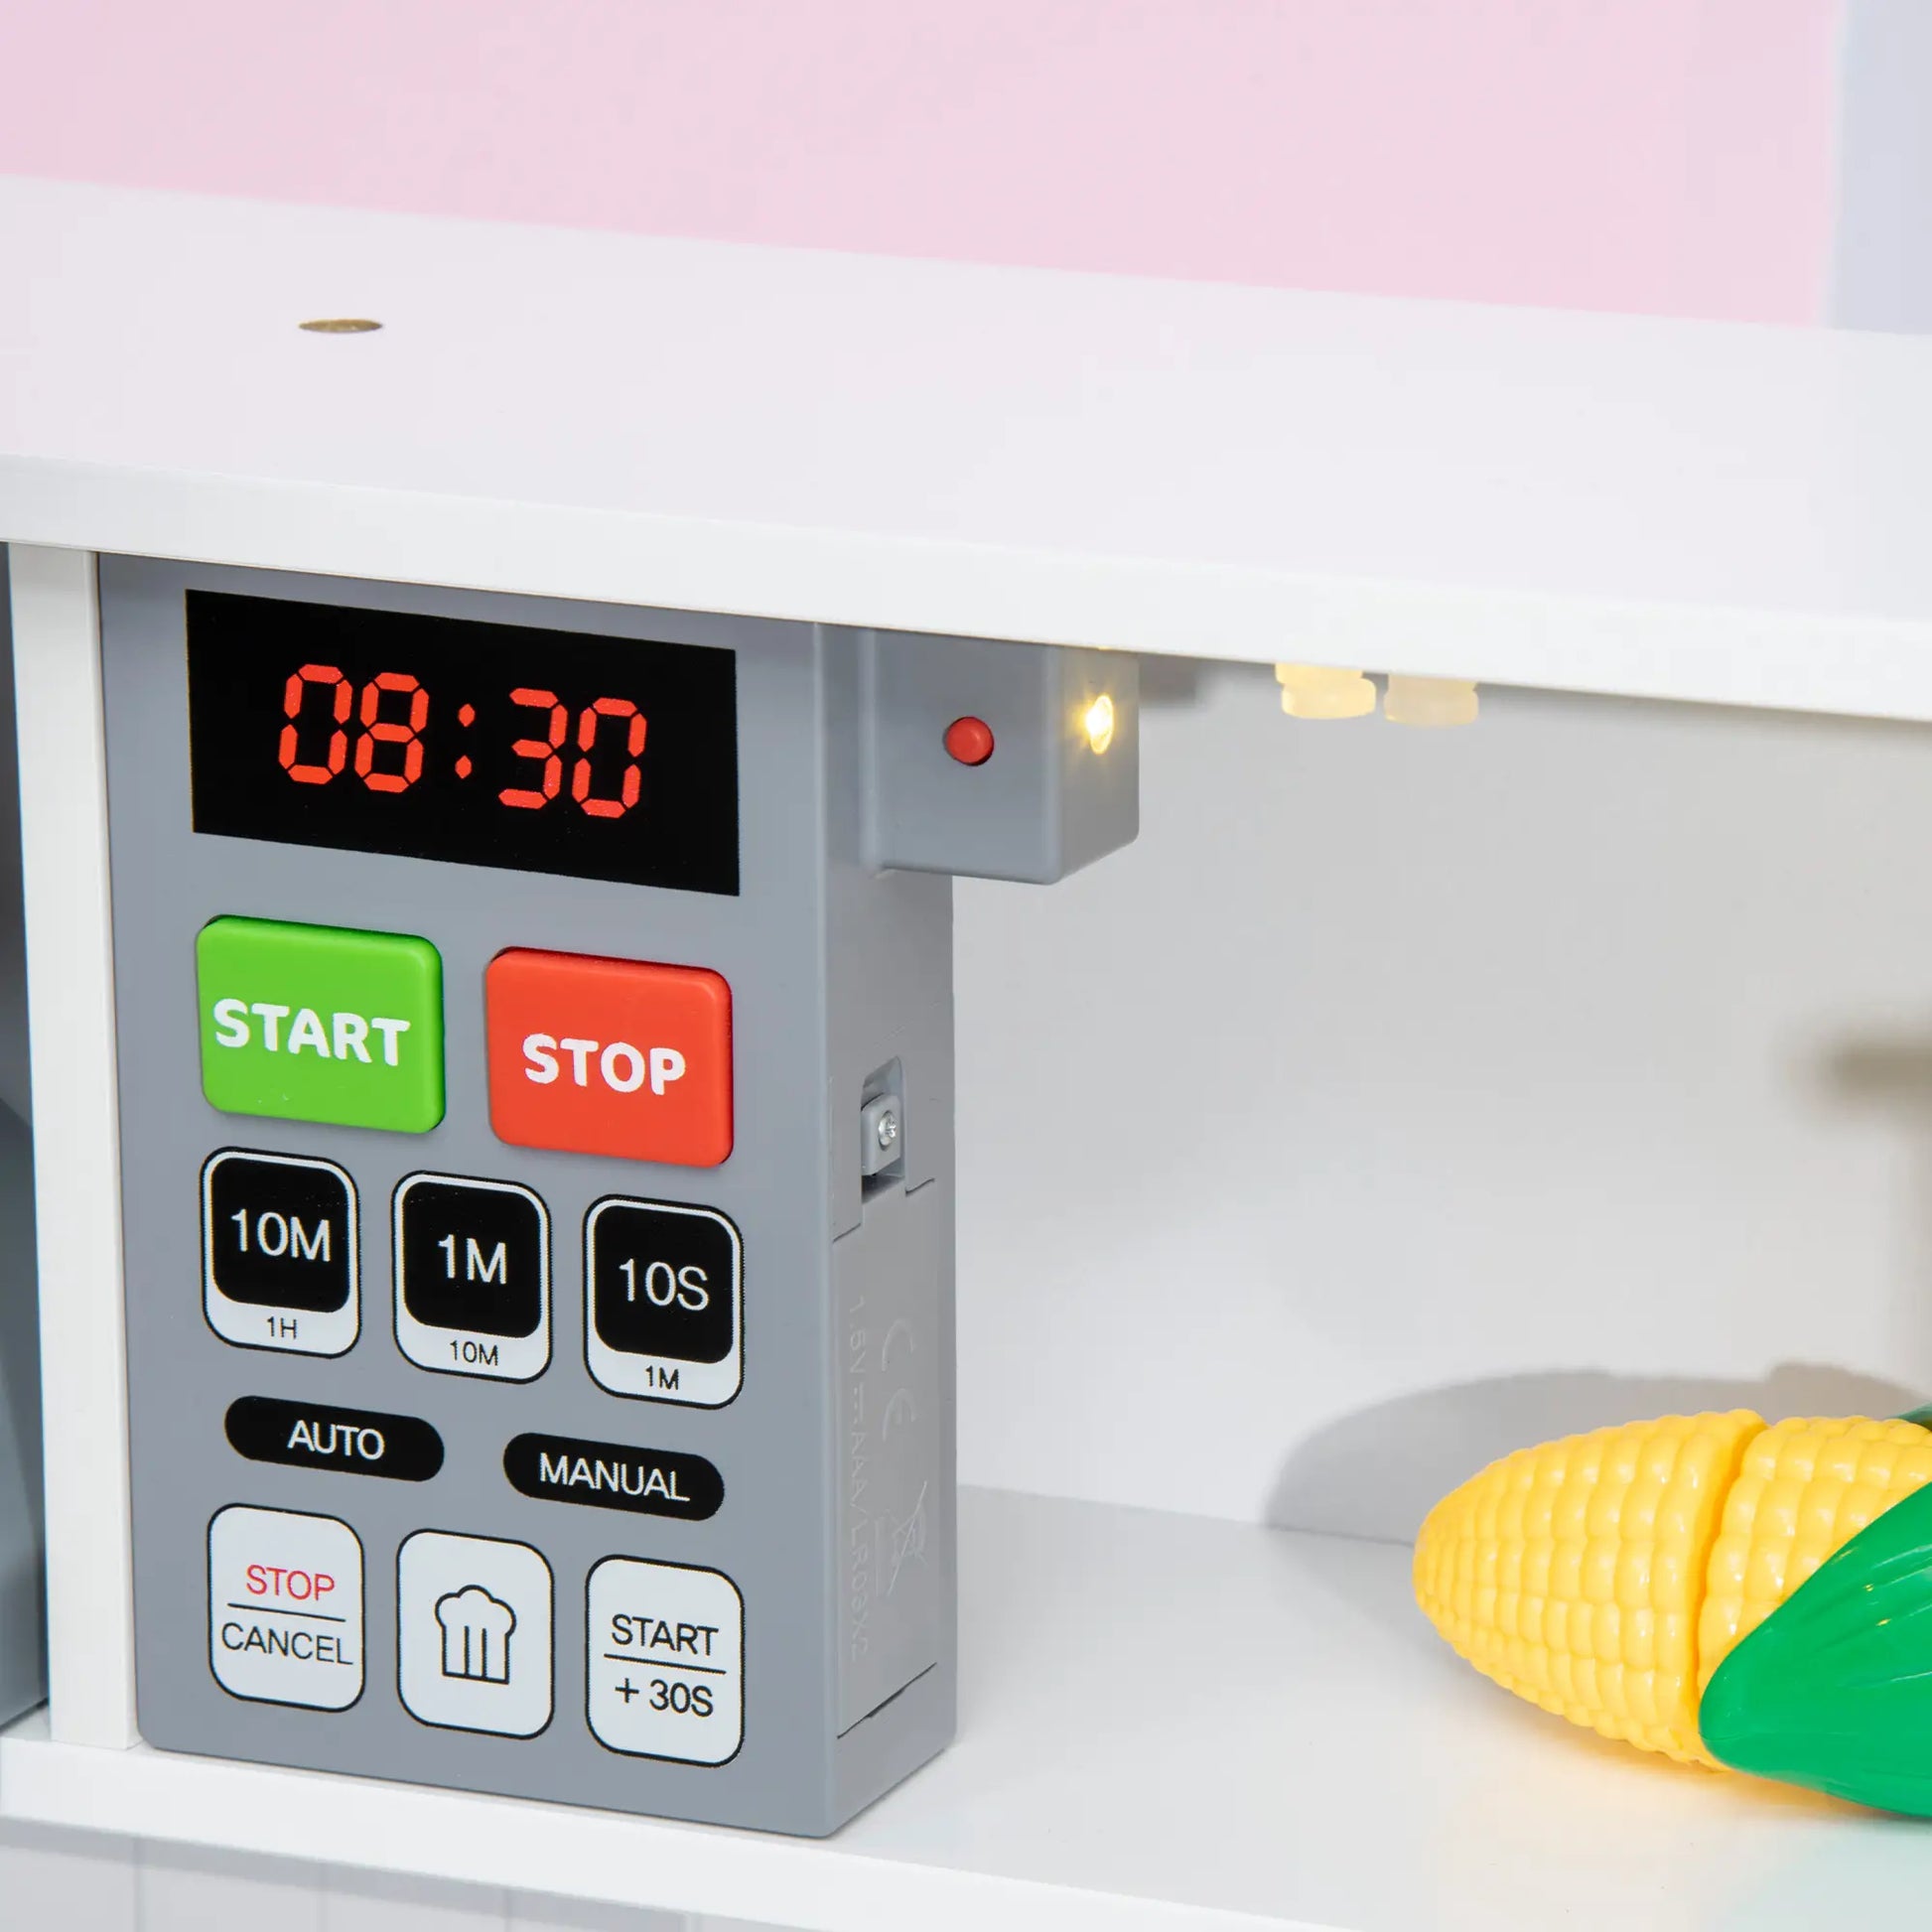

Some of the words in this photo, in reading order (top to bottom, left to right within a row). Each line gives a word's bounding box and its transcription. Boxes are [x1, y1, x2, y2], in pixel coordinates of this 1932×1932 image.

[279, 664, 646, 818] 08:30
[213, 999, 410, 1066] START
[521, 1034, 685, 1095] STOP
[231, 1209, 331, 1262] 10M
[438, 1234, 507, 1285] 1M
[620, 1259, 710, 1311] 10S
[266, 1316, 297, 1339] 1H
[450, 1340, 499, 1367] 10M
[645, 1366, 679, 1391] 1M
[287, 1420, 385, 1460] AUTO
[540, 1452, 691, 1502] MANUAL
[245, 1564, 336, 1600] STOP
[220, 1622, 353, 1665] CANCEL
[612, 1614, 719, 1656] START
